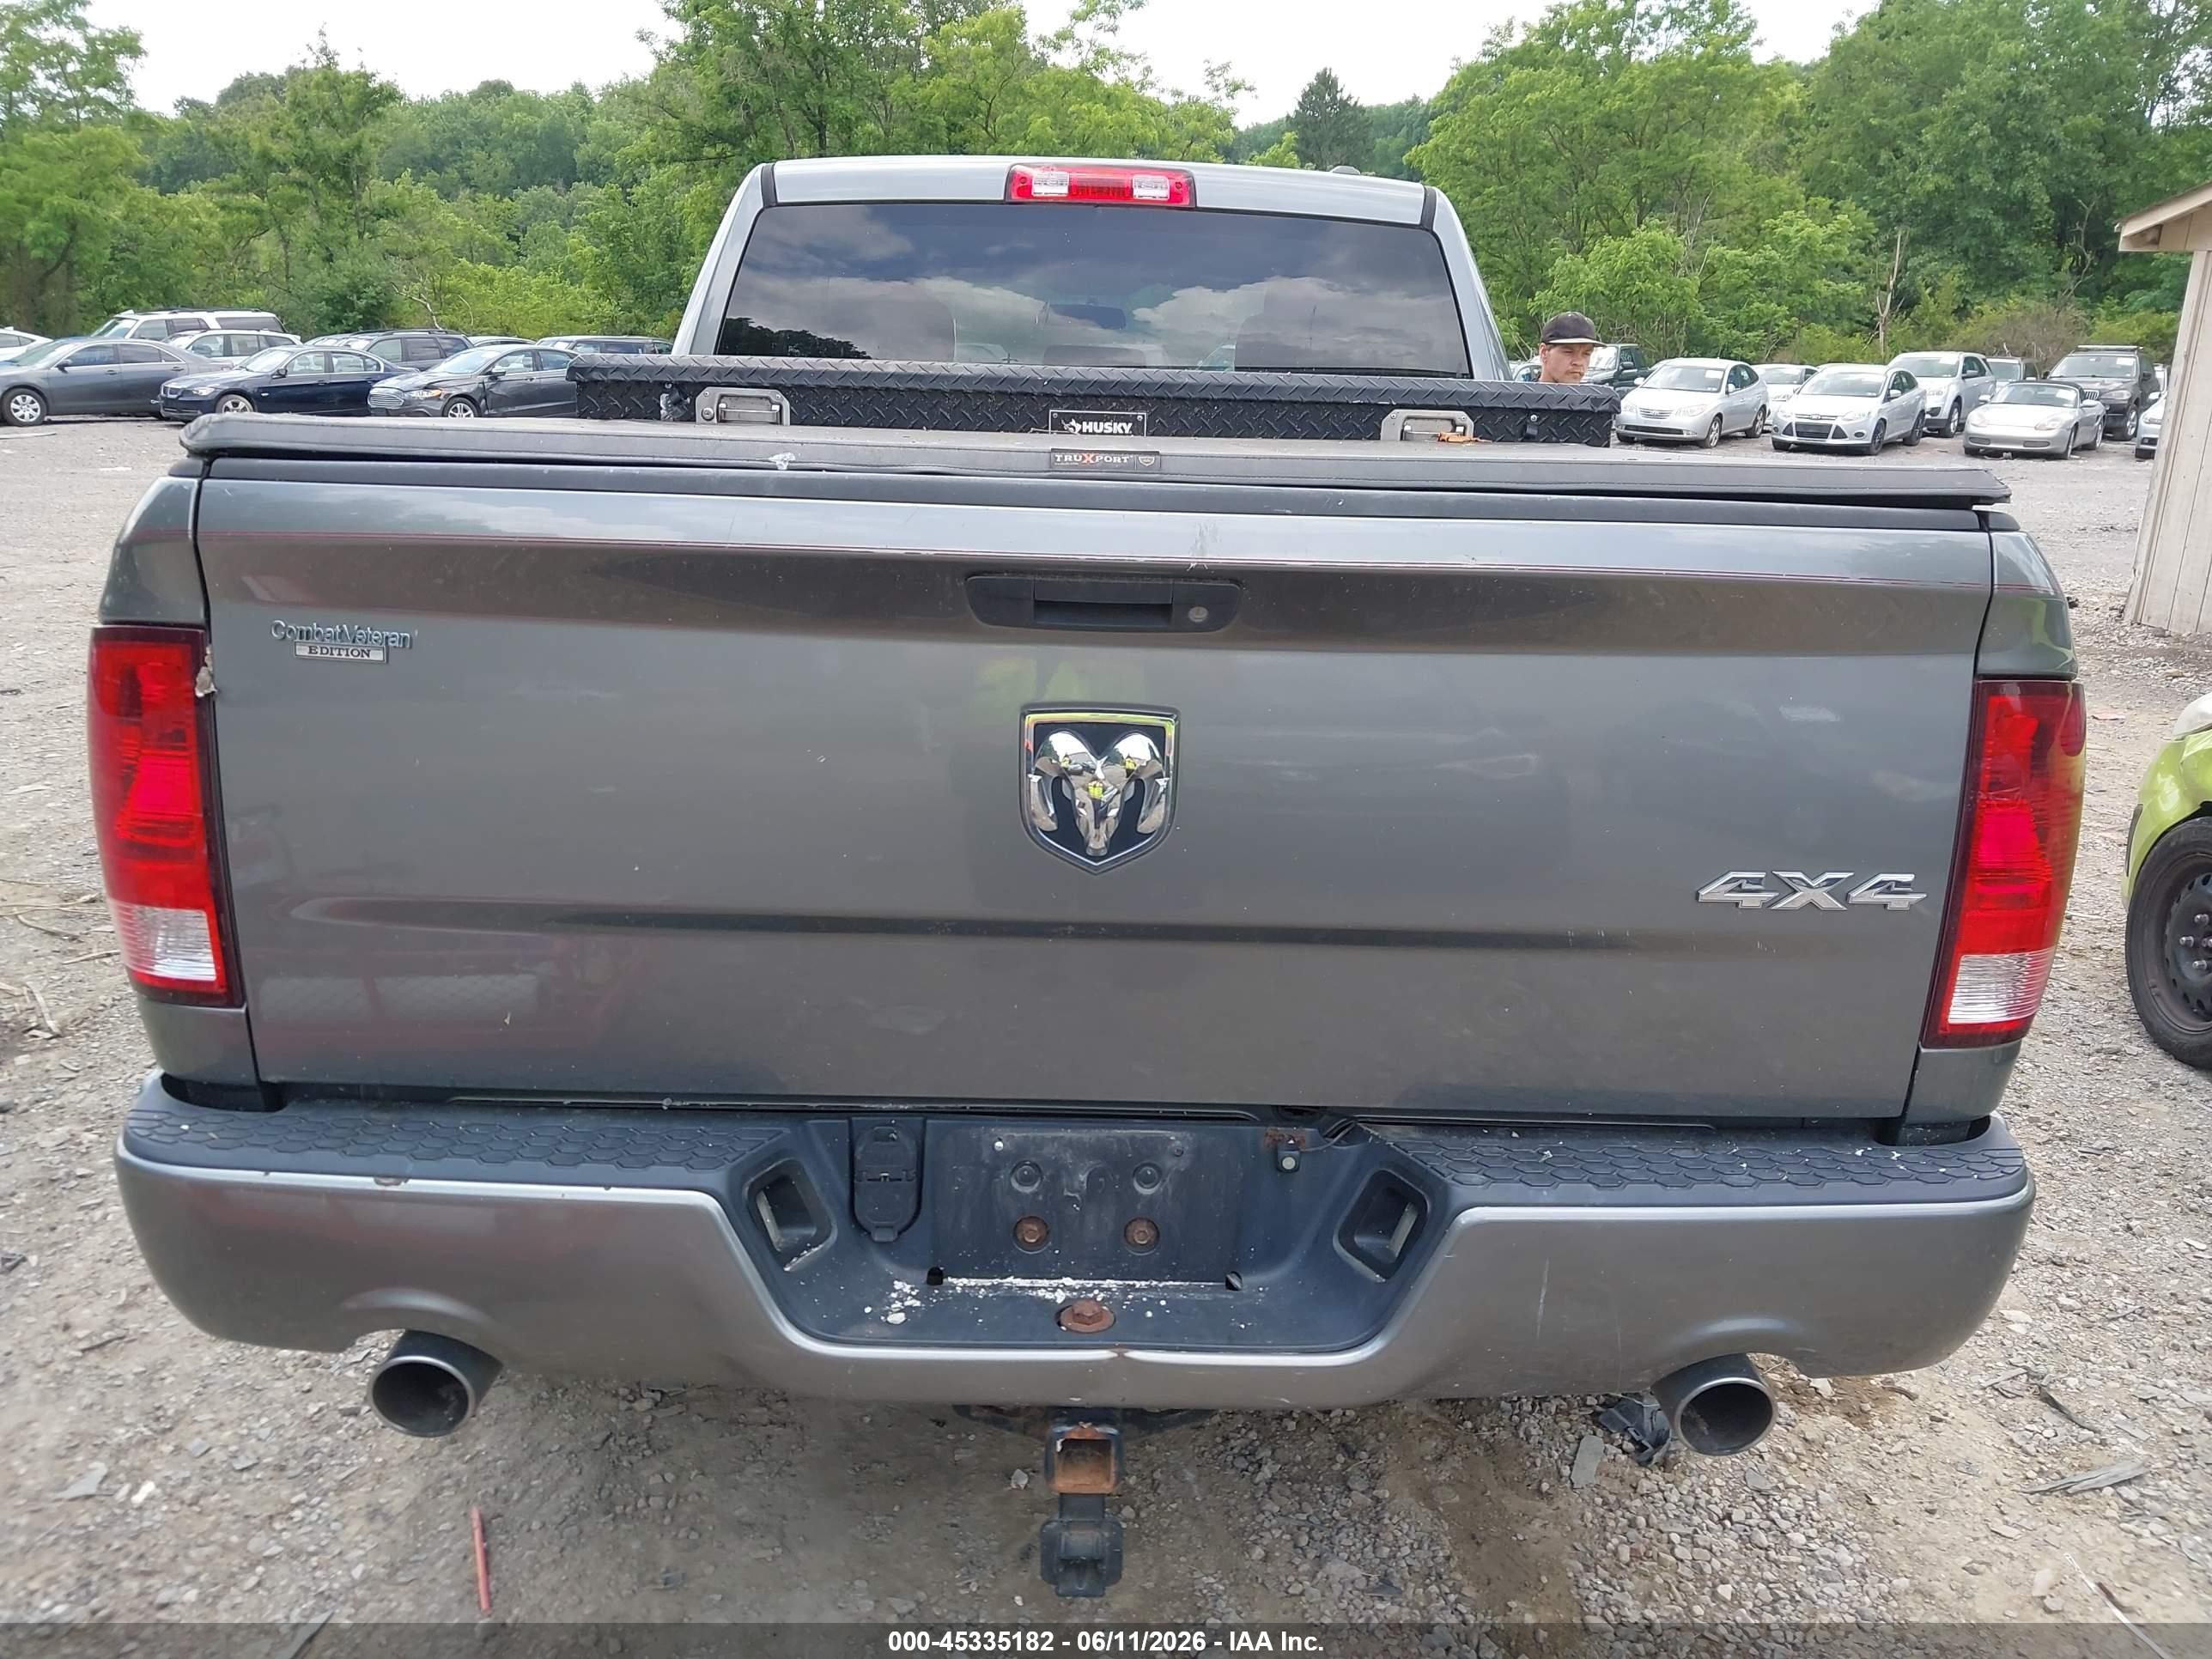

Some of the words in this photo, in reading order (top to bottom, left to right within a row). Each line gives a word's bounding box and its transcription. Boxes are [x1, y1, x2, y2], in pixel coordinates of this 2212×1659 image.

[1082, 421, 1133, 434] HUSKY
[1054, 452, 1131, 465] TRUXPORT
[308, 645, 371, 659] EDITION
